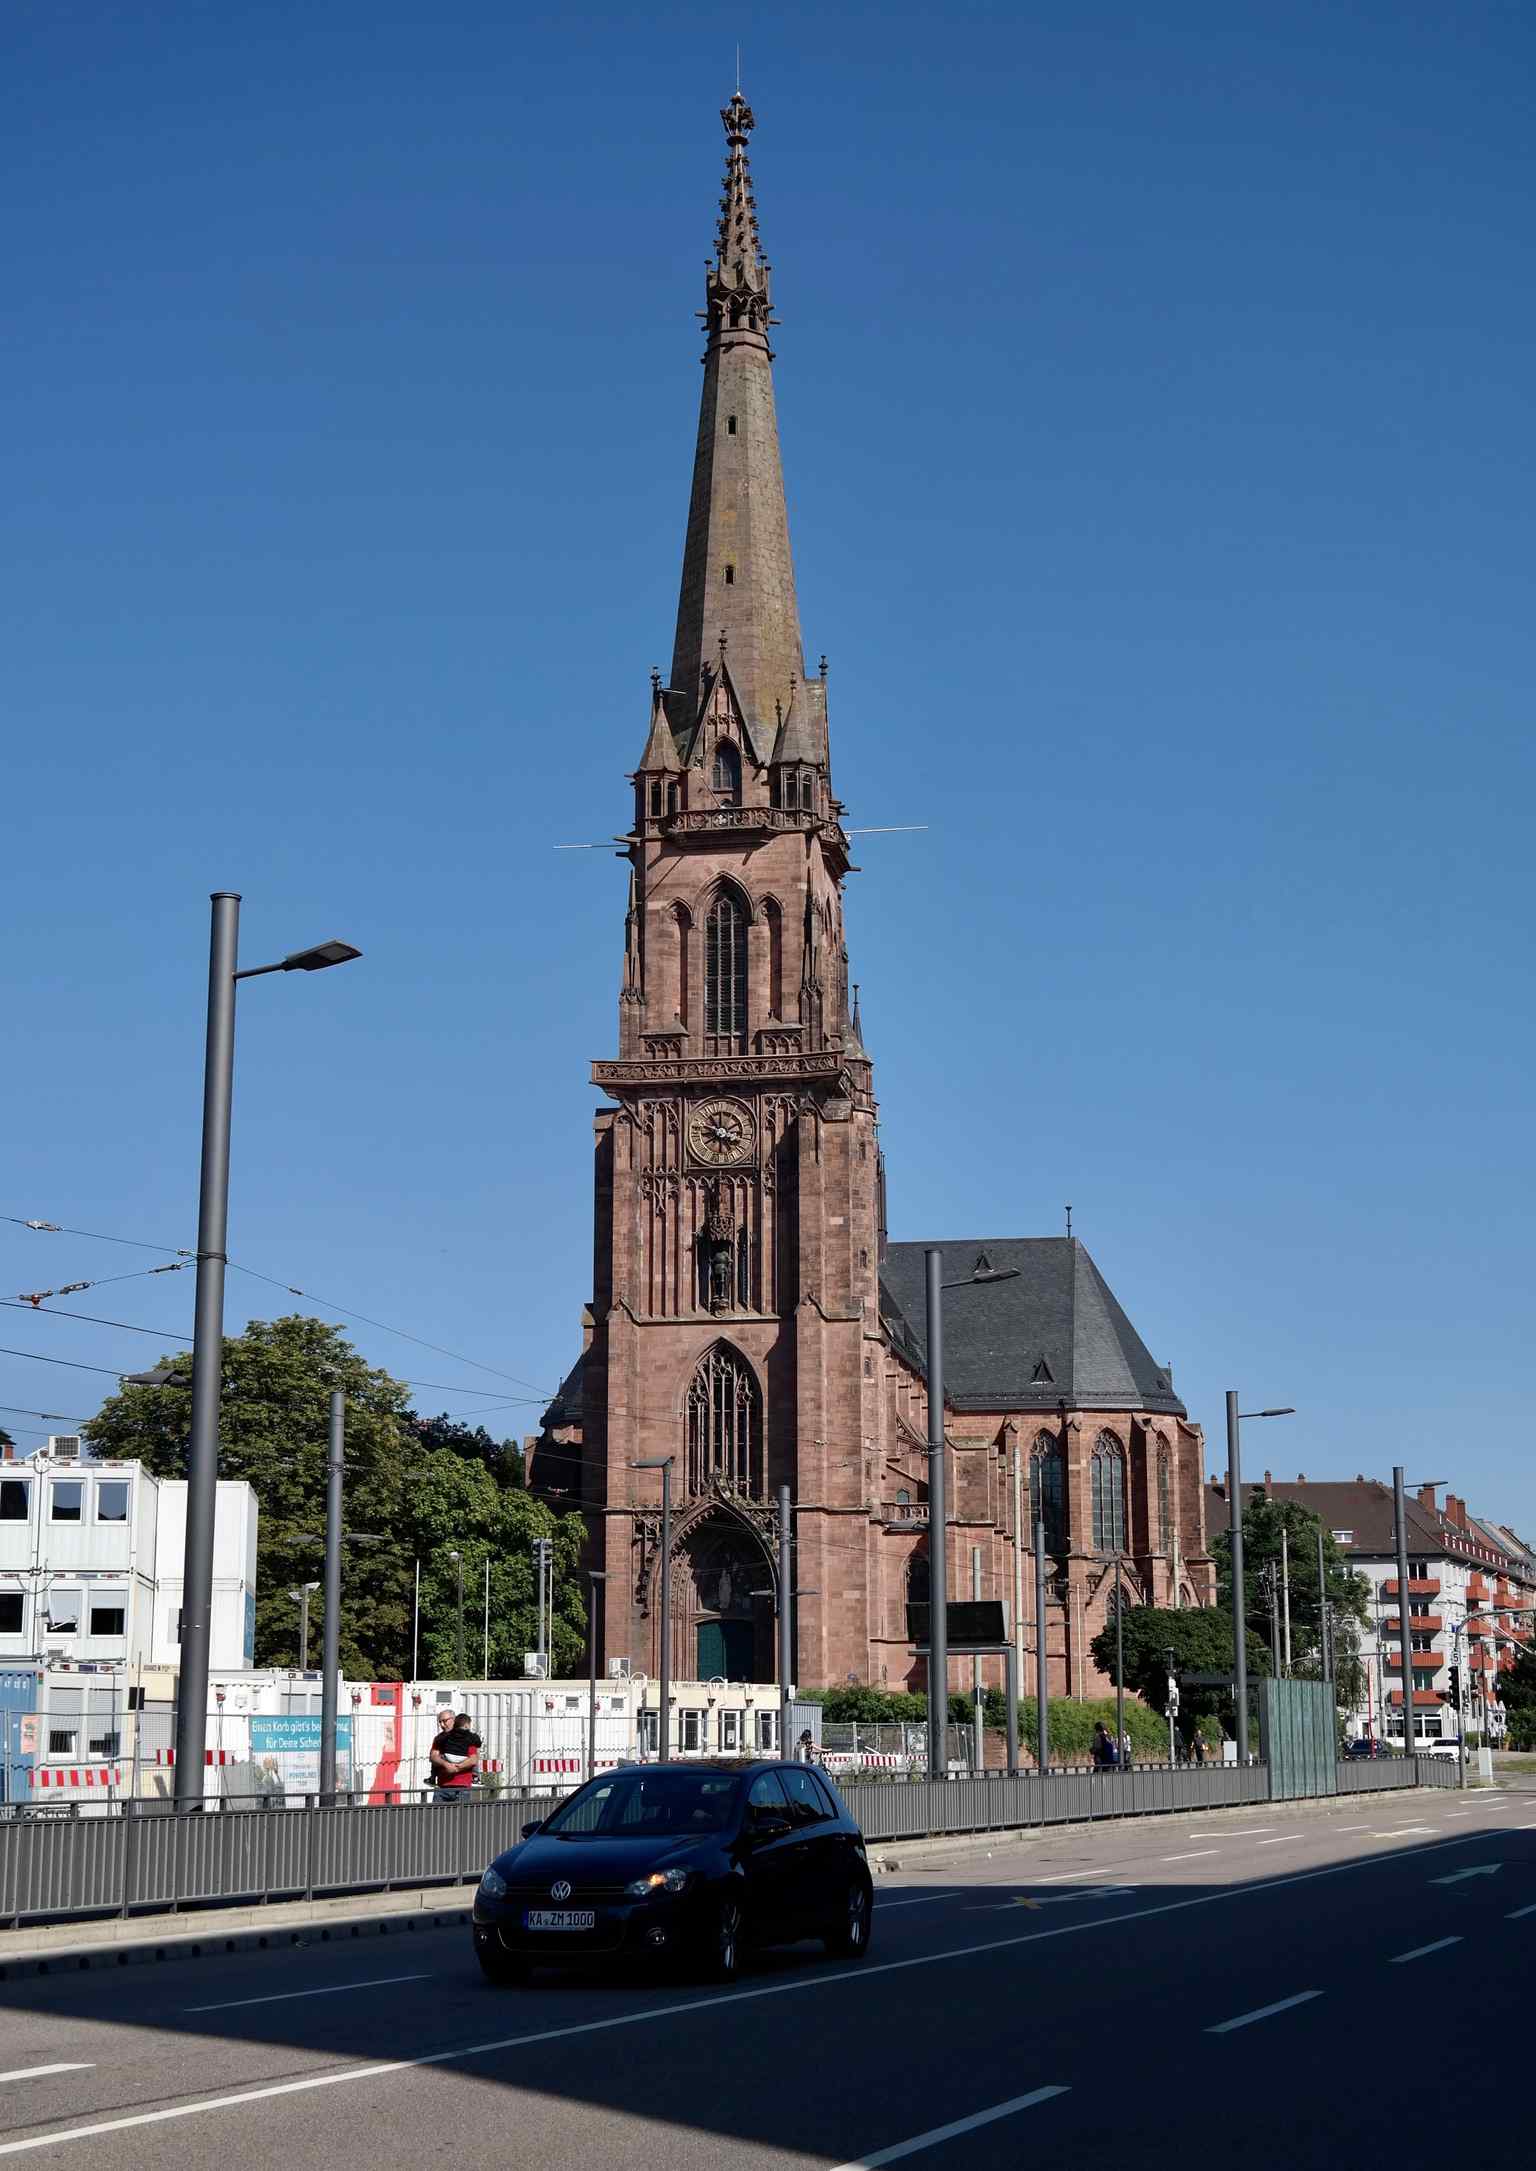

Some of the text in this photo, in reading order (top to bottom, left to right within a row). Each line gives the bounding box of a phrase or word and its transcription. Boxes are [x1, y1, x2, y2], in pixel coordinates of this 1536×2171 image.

[273, 1720, 289, 1732] Korb
[266, 1736, 277, 1748] für
[529, 1912, 542, 1926] KA
[566, 1912, 593, 1926] 1000
